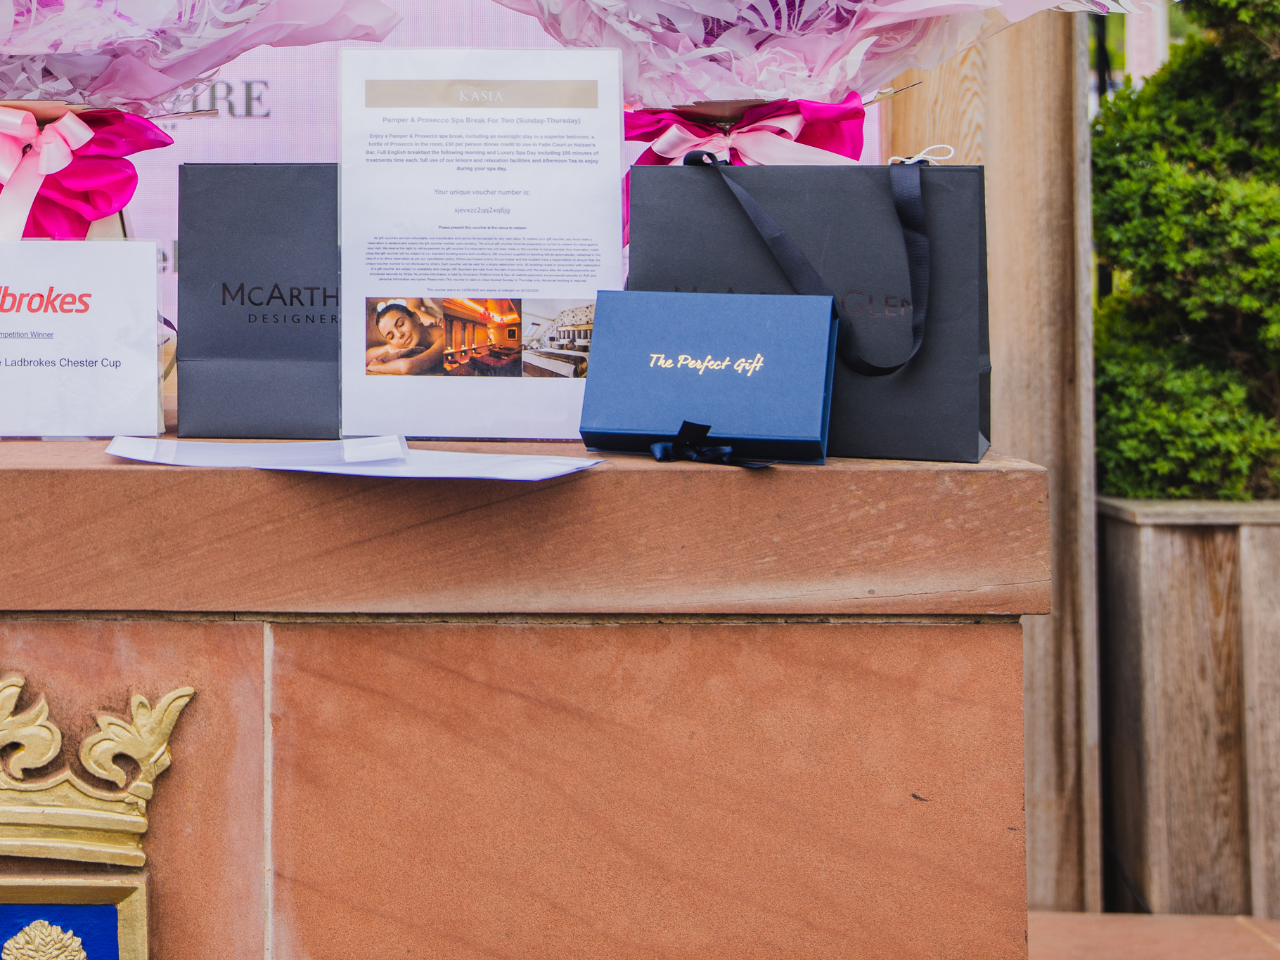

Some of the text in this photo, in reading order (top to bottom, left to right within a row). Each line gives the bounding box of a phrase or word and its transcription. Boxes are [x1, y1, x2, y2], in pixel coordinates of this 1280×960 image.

[460, 90, 504, 102] KASIA
[382, 117, 409, 125] Pamper
[515, 117, 581, 125] (Sunday-Thursday)
[434, 188, 449, 196] Your
[449, 188, 471, 197] unique
[471, 188, 497, 196] voucher
[497, 188, 522, 196] number
[248, 313, 339, 324] DESIGNER
[29, 330, 55, 339] Winner
[4, 357, 57, 369] Ladbrokes
[58, 357, 98, 369] Chester
[99, 357, 122, 370] Cup
[648, 352, 765, 377] The Perfect Gift
